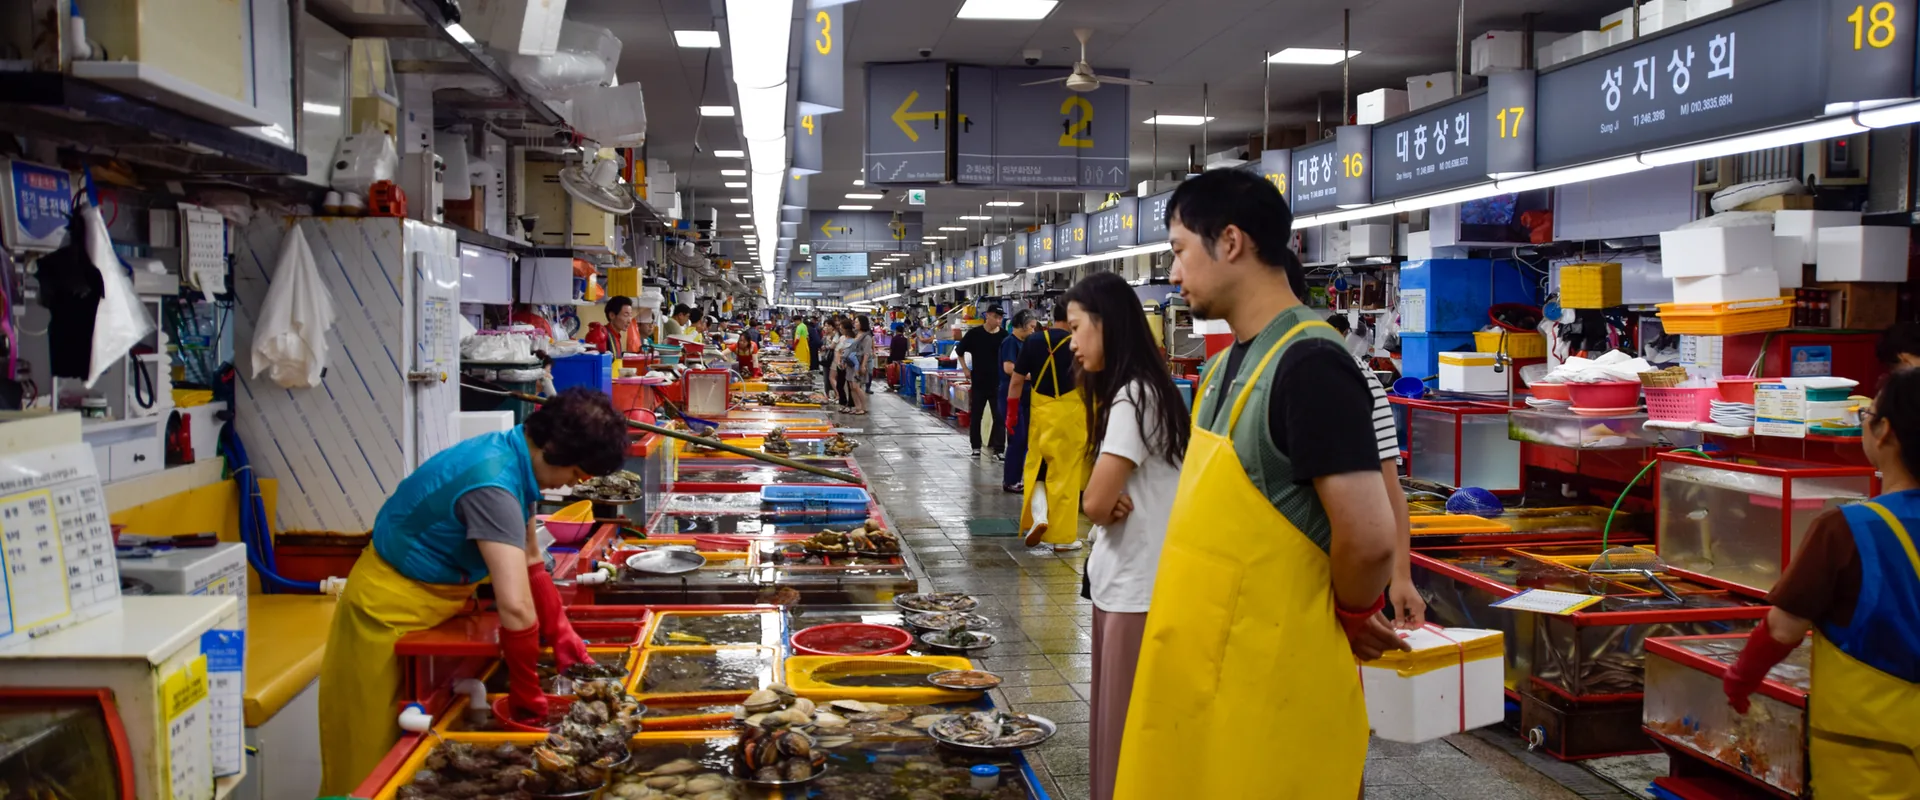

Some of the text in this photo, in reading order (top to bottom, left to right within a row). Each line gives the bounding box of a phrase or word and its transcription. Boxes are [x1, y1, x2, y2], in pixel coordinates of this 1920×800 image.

[815, 10, 832, 55] 3
[1847, 1, 1896, 51] 18
[1600, 31, 1736, 112] 성지상회
[801, 115, 815, 136] 4
[1059, 95, 1094, 149] 2
[1396, 112, 1470, 163] 대흥상회
[1496, 106, 1525, 139] 17
[1298, 152, 1338, 186] 대흥상
[1342, 151, 1363, 178] 16
[1073, 227, 1084, 241] 13
[1121, 213, 1133, 229] 14
[1018, 244, 1025, 256] 11
[1043, 237, 1052, 250] 12
